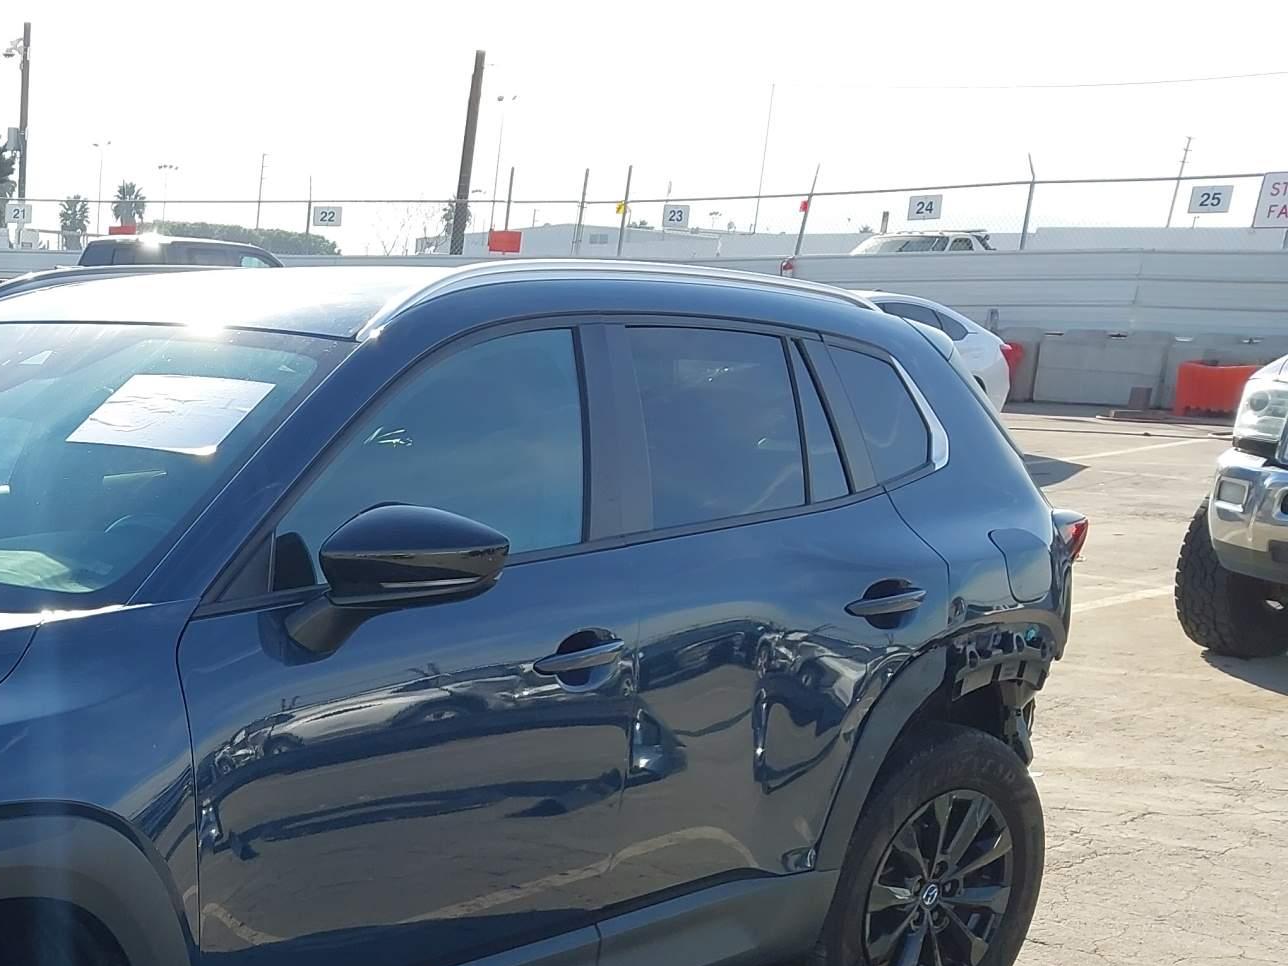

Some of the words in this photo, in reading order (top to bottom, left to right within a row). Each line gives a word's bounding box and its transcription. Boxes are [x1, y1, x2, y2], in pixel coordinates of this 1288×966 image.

[1198, 192, 1222, 207] 25
[915, 200, 934, 215] 24
[12, 208, 26, 220] 21
[319, 211, 336, 223] 22
[668, 210, 684, 222] 23
